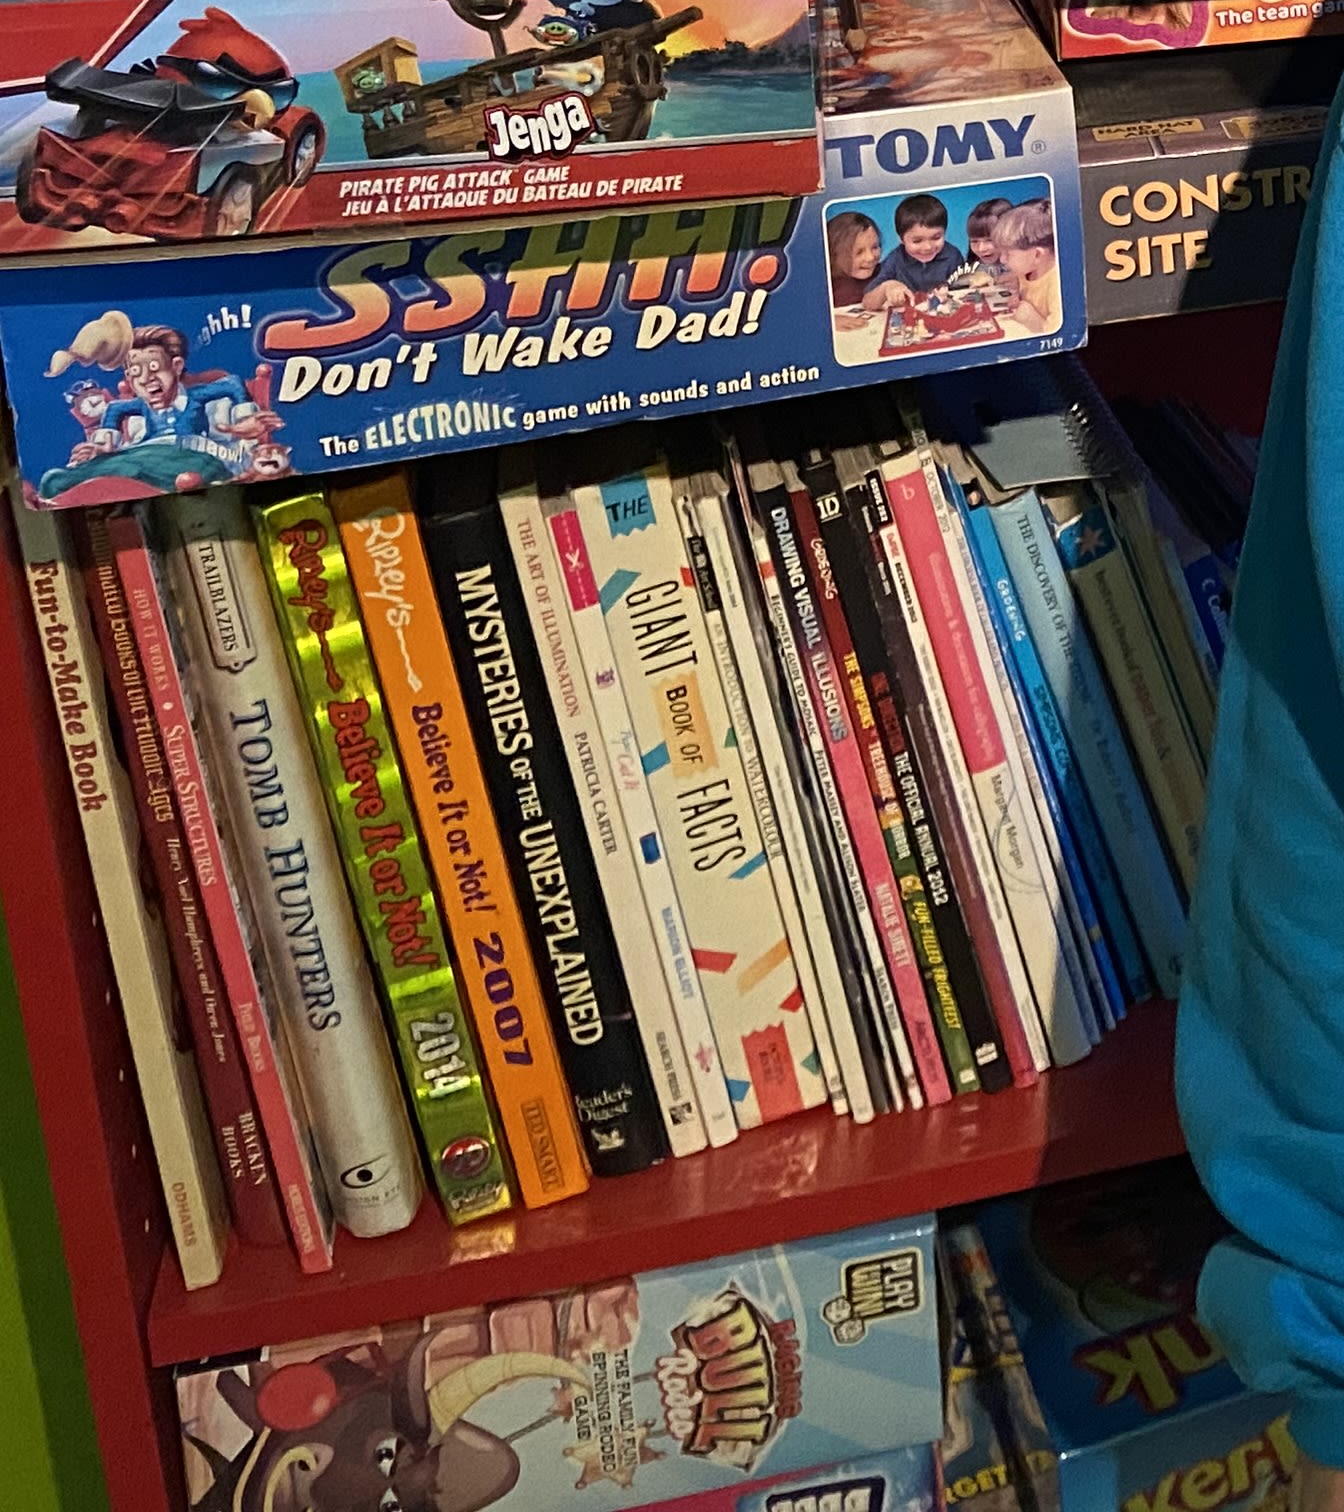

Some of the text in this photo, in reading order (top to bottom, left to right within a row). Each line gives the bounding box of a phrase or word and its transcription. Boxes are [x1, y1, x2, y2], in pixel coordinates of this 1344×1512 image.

[1216, 9, 1253, 27] The
[1257, 3, 1308, 22] team
[490, 94, 591, 157] Jenga
[824, 114, 1036, 180] TOMY
[339, 177, 404, 199] PIRATE
[408, 174, 438, 192] PIG
[524, 166, 570, 184] GAME
[342, 199, 372, 218] JEU
[393, 191, 488, 213] L'ATTAQUE
[493, 187, 518, 206] DU
[522, 182, 592, 204] BATEAU
[596, 180, 618, 198] DE
[621, 175, 684, 195] PIRATE
[1103, 229, 1212, 281] SITE
[278, 289, 768, 403] Don't Wake Dad!
[1040, 337, 1063, 350] 7149
[319, 364, 820, 458] The ELECTRONIC game with sounds and action
[816, 498, 840, 520] 1D
[197, 543, 238, 652] TRAILBLAZERS
[1015, 514, 1067, 632] THE DISCOVERY OF
[769, 506, 847, 742] DRAWING VISUAL ILLUSIONS
[841, 651, 860, 676] THE
[29, 558, 109, 815] Fun-to-Make Book
[132, 587, 151, 621] HOW
[147, 644, 168, 691] WORKS
[162, 723, 195, 780] SUPER
[514, 518, 619, 855] THE ART OF ILLUMINATION PATRICIA CARTER
[606, 495, 748, 881] THE GIANT BOOK OF FACTS
[846, 673, 875, 730] SIMPSONS
[325, 692, 390, 821] Believe
[409, 698, 456, 796] Believe
[357, 816, 408, 859] It
[435, 794, 470, 825] It
[444, 827, 471, 857] or
[452, 563, 607, 1048] MYSTERIES OF THE UNEXPLAINED
[891, 751, 951, 907] THE OFFICIAL ANNUAL 2012
[227, 698, 342, 1034] TOMB HUNTERS
[367, 855, 407, 899] or
[451, 856, 497, 918] Not!
[379, 892, 438, 972] Not!
[468, 930, 538, 1072] 2007
[408, 1012, 473, 1098] 2014
[572, 1394, 592, 1441] GAME
[590, 1351, 617, 1472] SPINNING RODEO
[612, 1349, 638, 1467] THE FAMILY FUN
